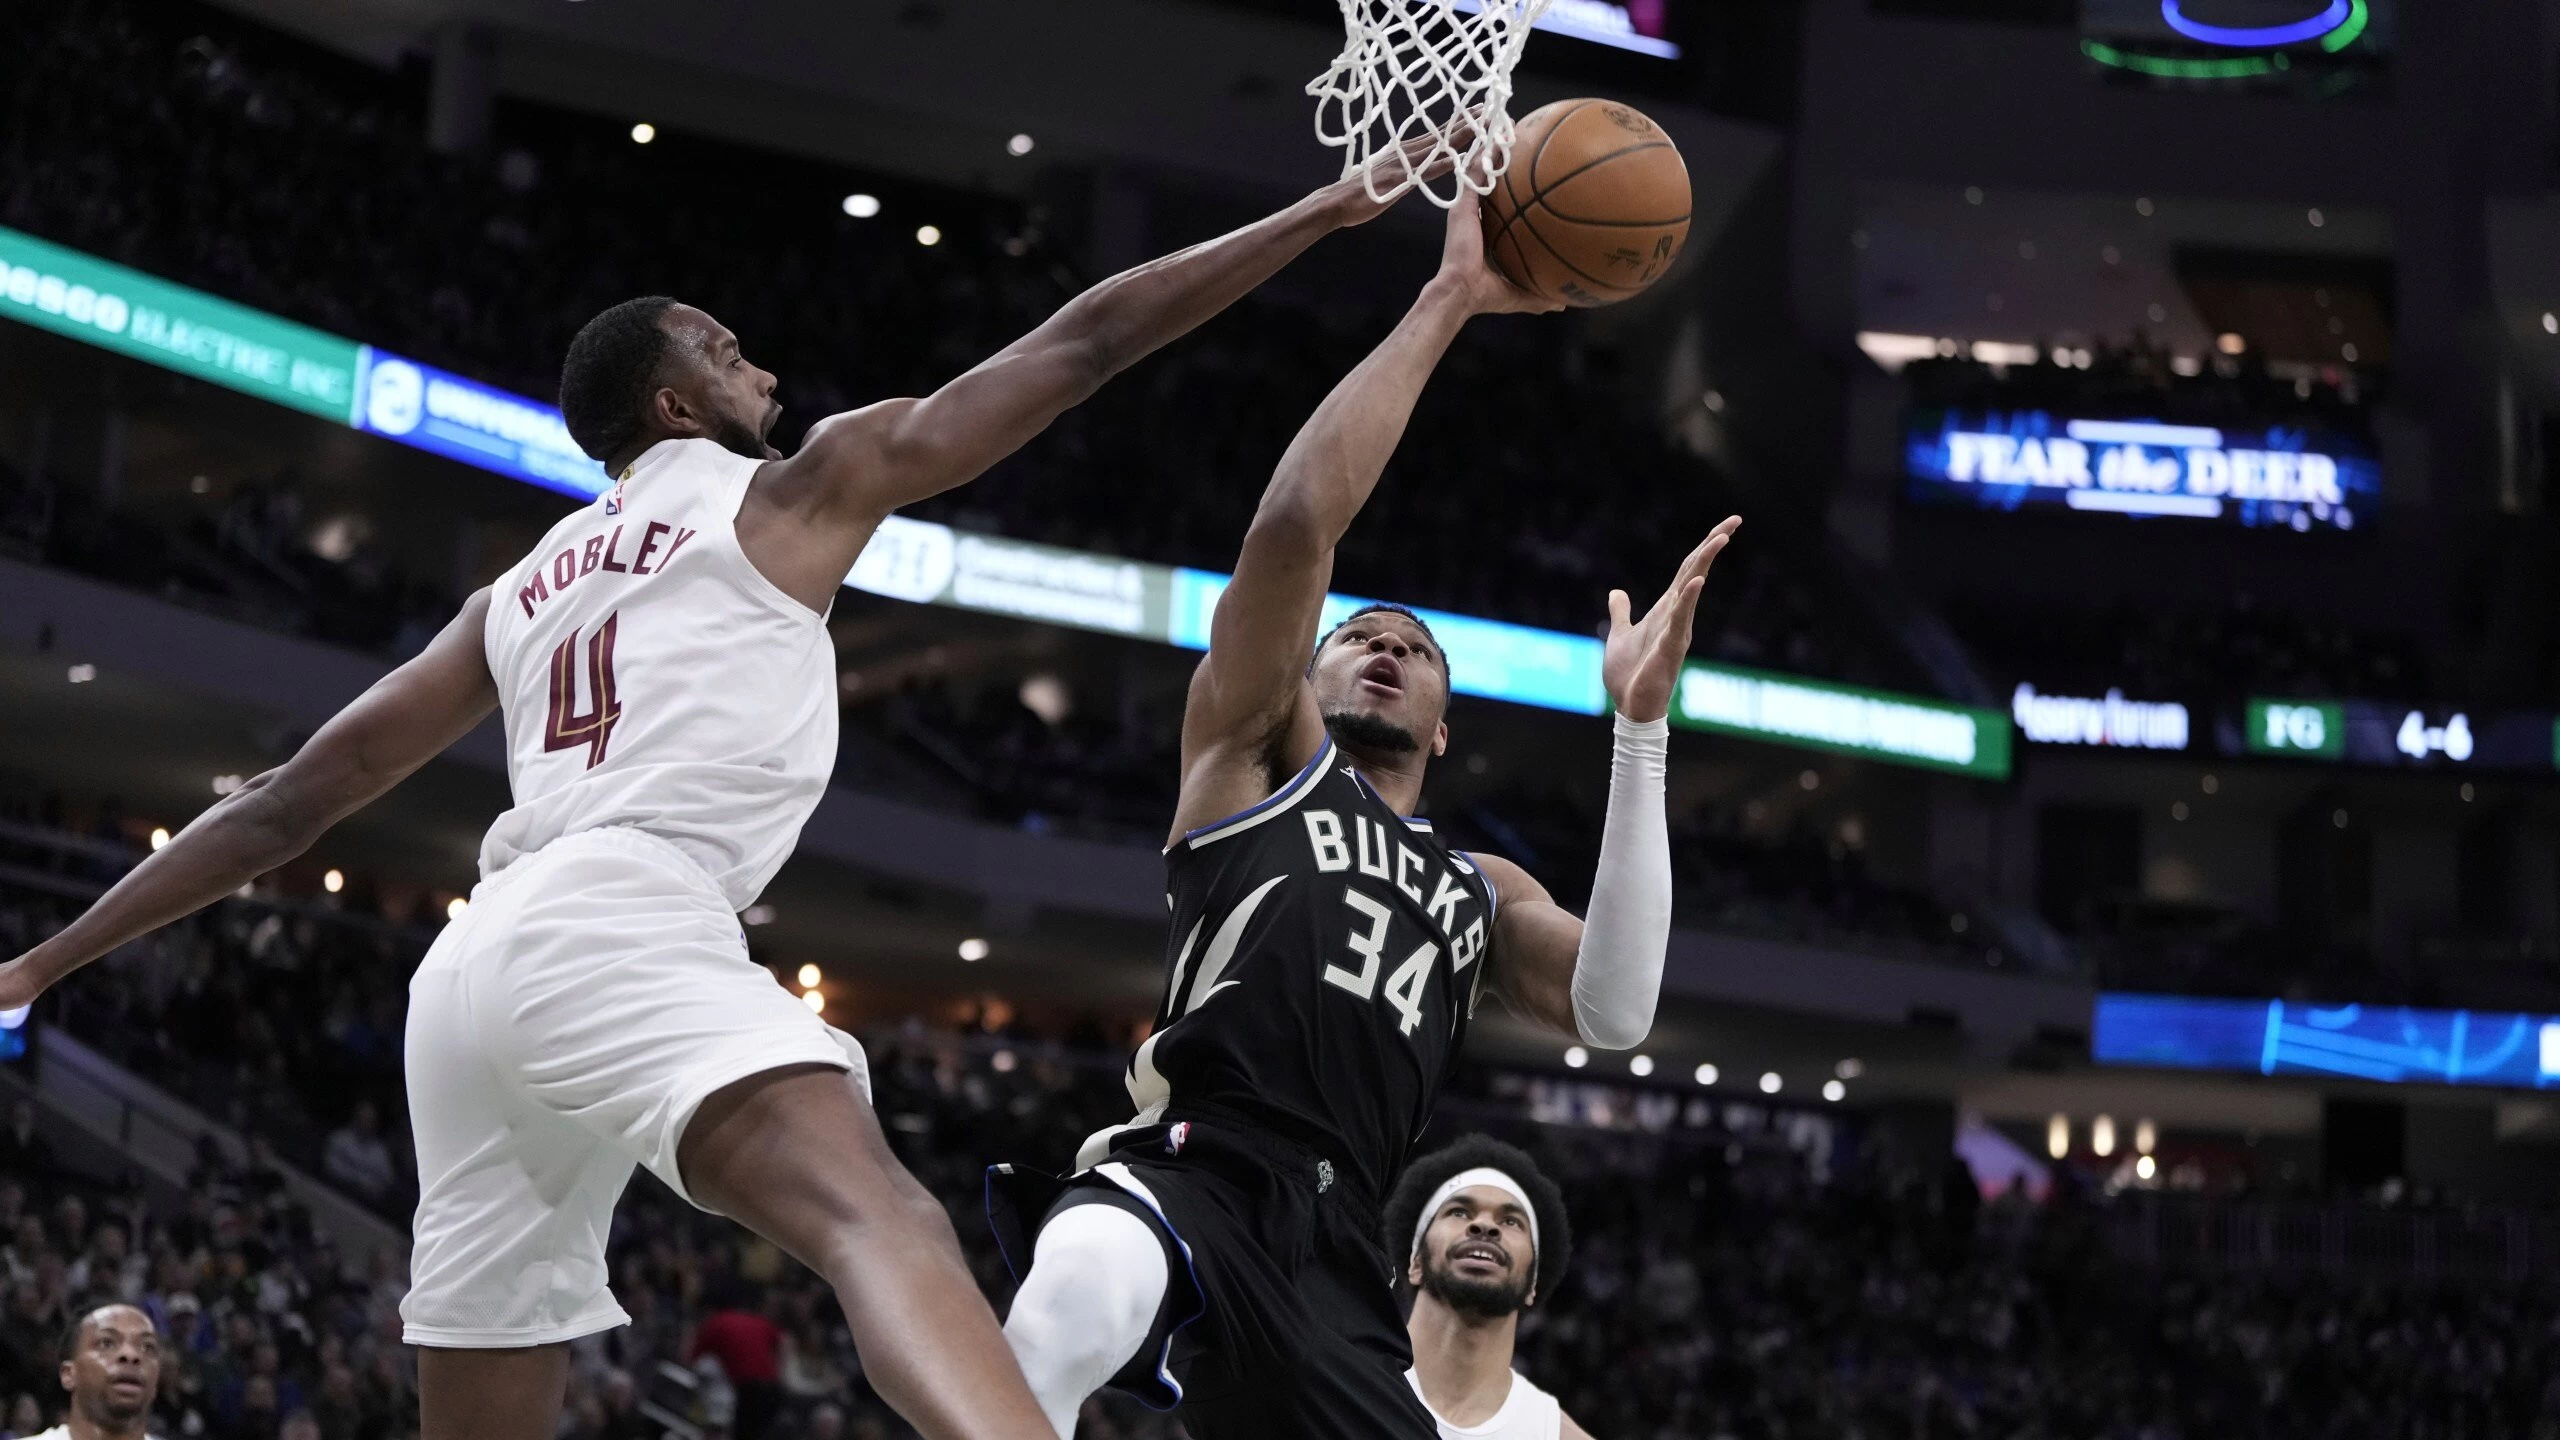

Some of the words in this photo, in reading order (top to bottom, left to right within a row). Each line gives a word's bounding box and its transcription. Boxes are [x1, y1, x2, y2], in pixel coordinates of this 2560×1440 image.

[1947, 432, 2093, 488] FEAR
[2098, 444, 2179, 493] the
[2186, 448, 2343, 503] DEER
[519, 521, 696, 620] MOBLEY
[545, 610, 621, 771] 4
[2266, 704, 2324, 749] FG
[1302, 809, 1485, 973] BUCKS
[1321, 884, 1440, 1038] 34
